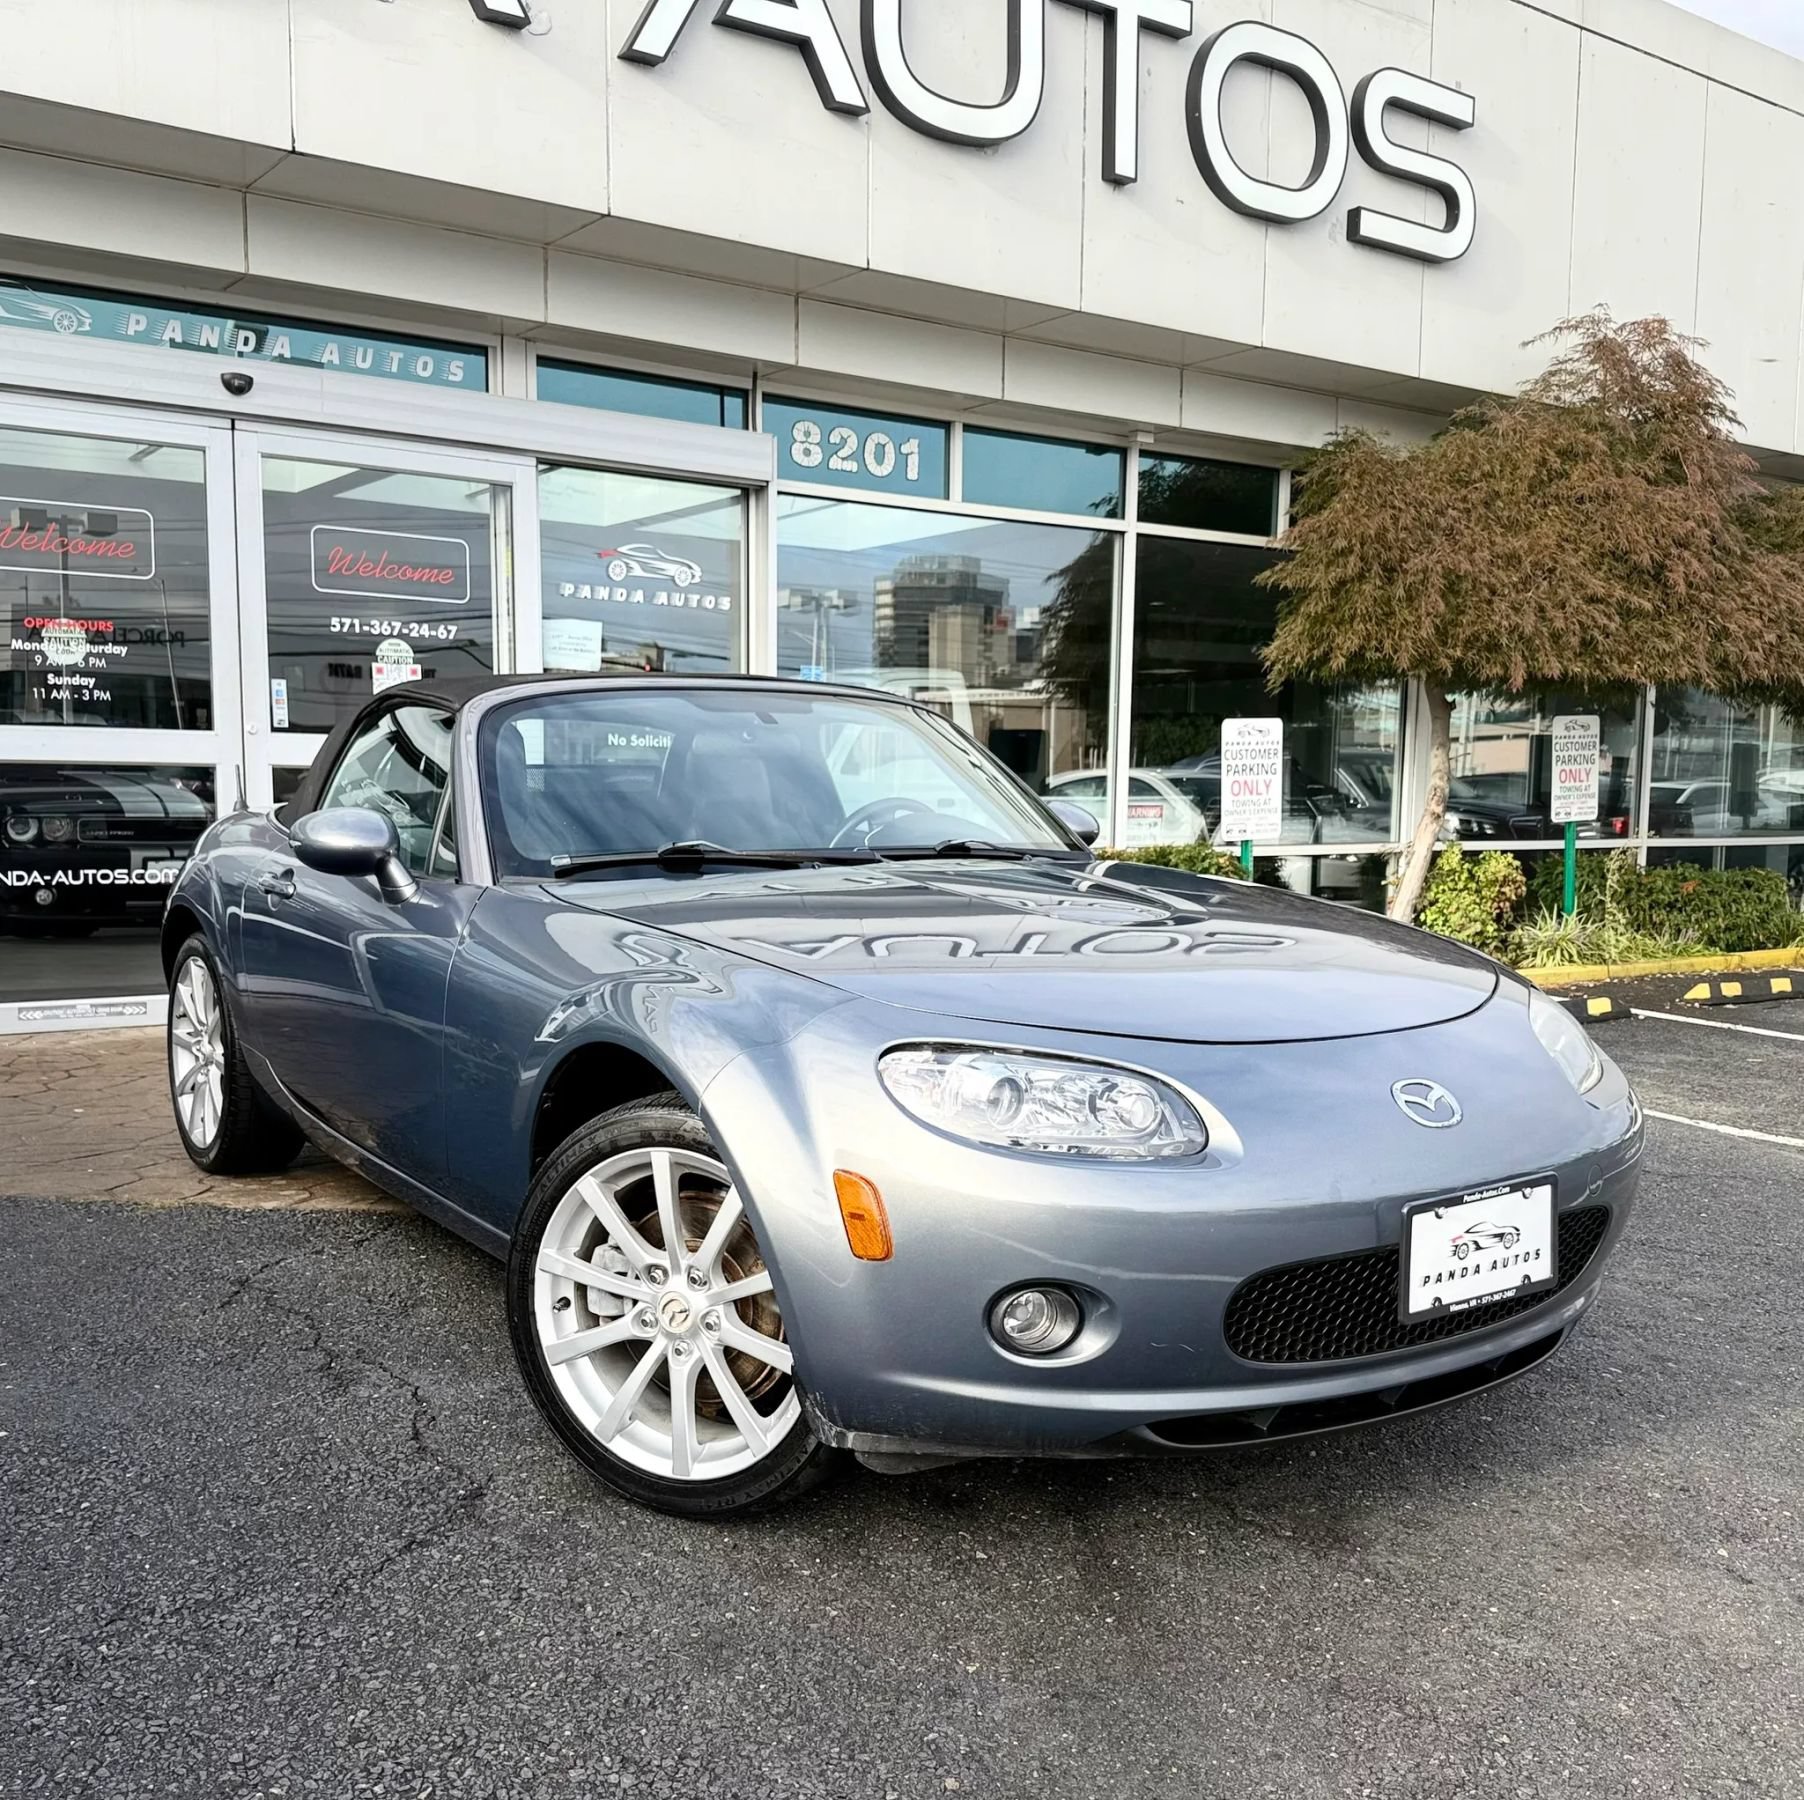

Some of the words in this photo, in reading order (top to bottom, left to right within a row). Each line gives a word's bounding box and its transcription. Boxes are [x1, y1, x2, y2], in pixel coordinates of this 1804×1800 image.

[113, 311, 293, 359] PANDA
[312, 341, 465, 383] AUTOS
[791, 420, 919, 481] 8201
[327, 545, 455, 584] Welcome
[560, 582, 644, 604] PANDA
[653, 591, 732, 611] AUTOS
[330, 617, 458, 640] 571-367-24-67
[34, 655, 43, 667] 9
[89, 656, 107, 668] PM
[47, 673, 96, 688] Sunday
[32, 687, 46, 700] 11
[51, 689, 70, 700] AM
[82, 689, 90, 701] 3
[93, 689, 111, 701] PM
[607, 732, 627, 746] No
[1554, 741, 1598, 753] CUSTOMER
[1224, 748, 1279, 761] CUSTOMER
[1555, 753, 1596, 767] PARKING
[1226, 762, 1277, 776] PARKING
[1559, 767, 1592, 784] ONLY
[1231, 779, 1272, 797] ONLY
[1559, 785, 1583, 793] TOWING
[1584, 784, 1591, 792] AT
[1231, 799, 1261, 808] TOWING
[1262, 798, 1271, 807] AT
[1420, 1263, 1481, 1287] PANDA
[1489, 1248, 1541, 1272] AUTOS
